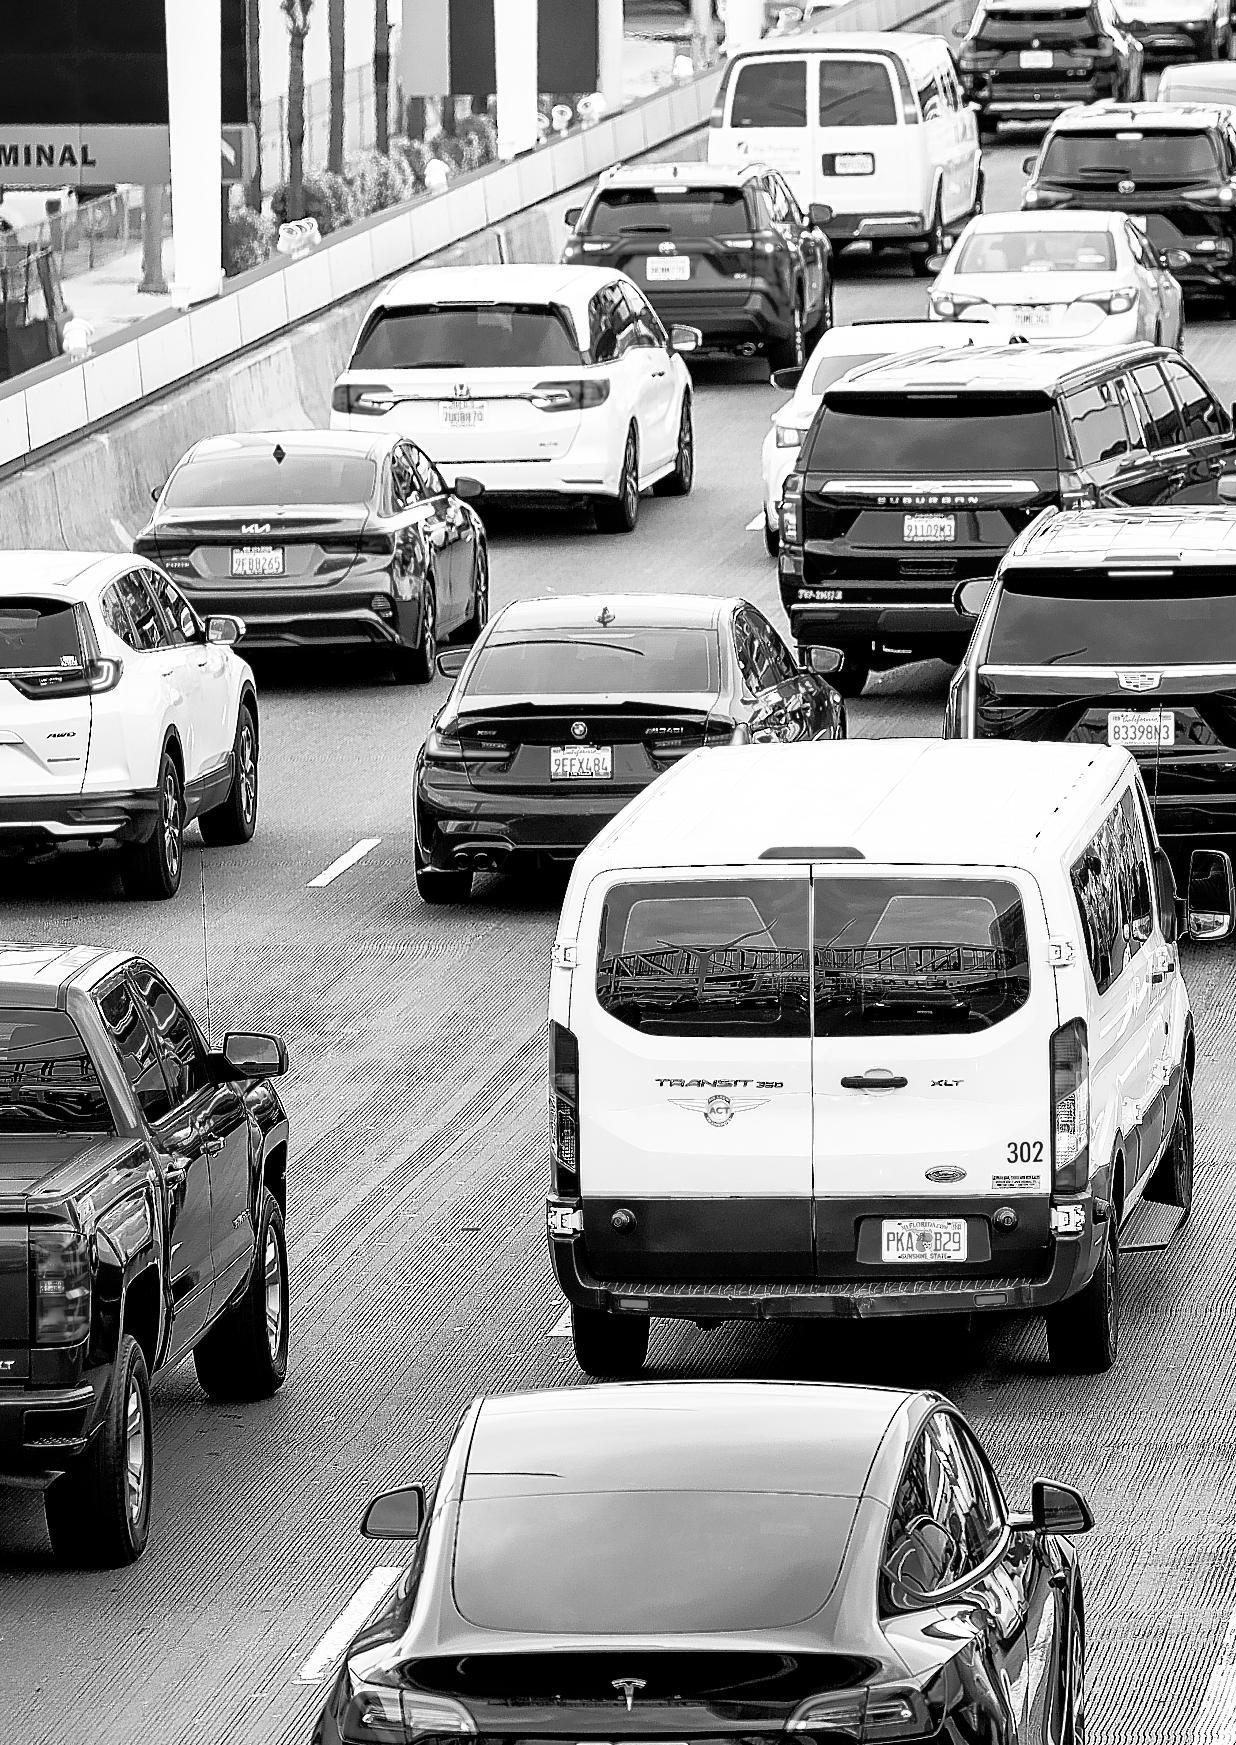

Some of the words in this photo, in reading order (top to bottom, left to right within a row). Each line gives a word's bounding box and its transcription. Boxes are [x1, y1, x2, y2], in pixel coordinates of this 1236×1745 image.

[0, 144, 97, 168] MINAL
[877, 496, 979, 505] SUBURBAN
[46, 731, 77, 739] AWD
[655, 1079, 754, 1088] TRANSIT
[930, 1079, 965, 1087] XLT
[709, 1106, 731, 1115] ACT
[1007, 1140, 1044, 1163] 302
[886, 1231, 914, 1252] PKA
[933, 1231, 961, 1252] B29
